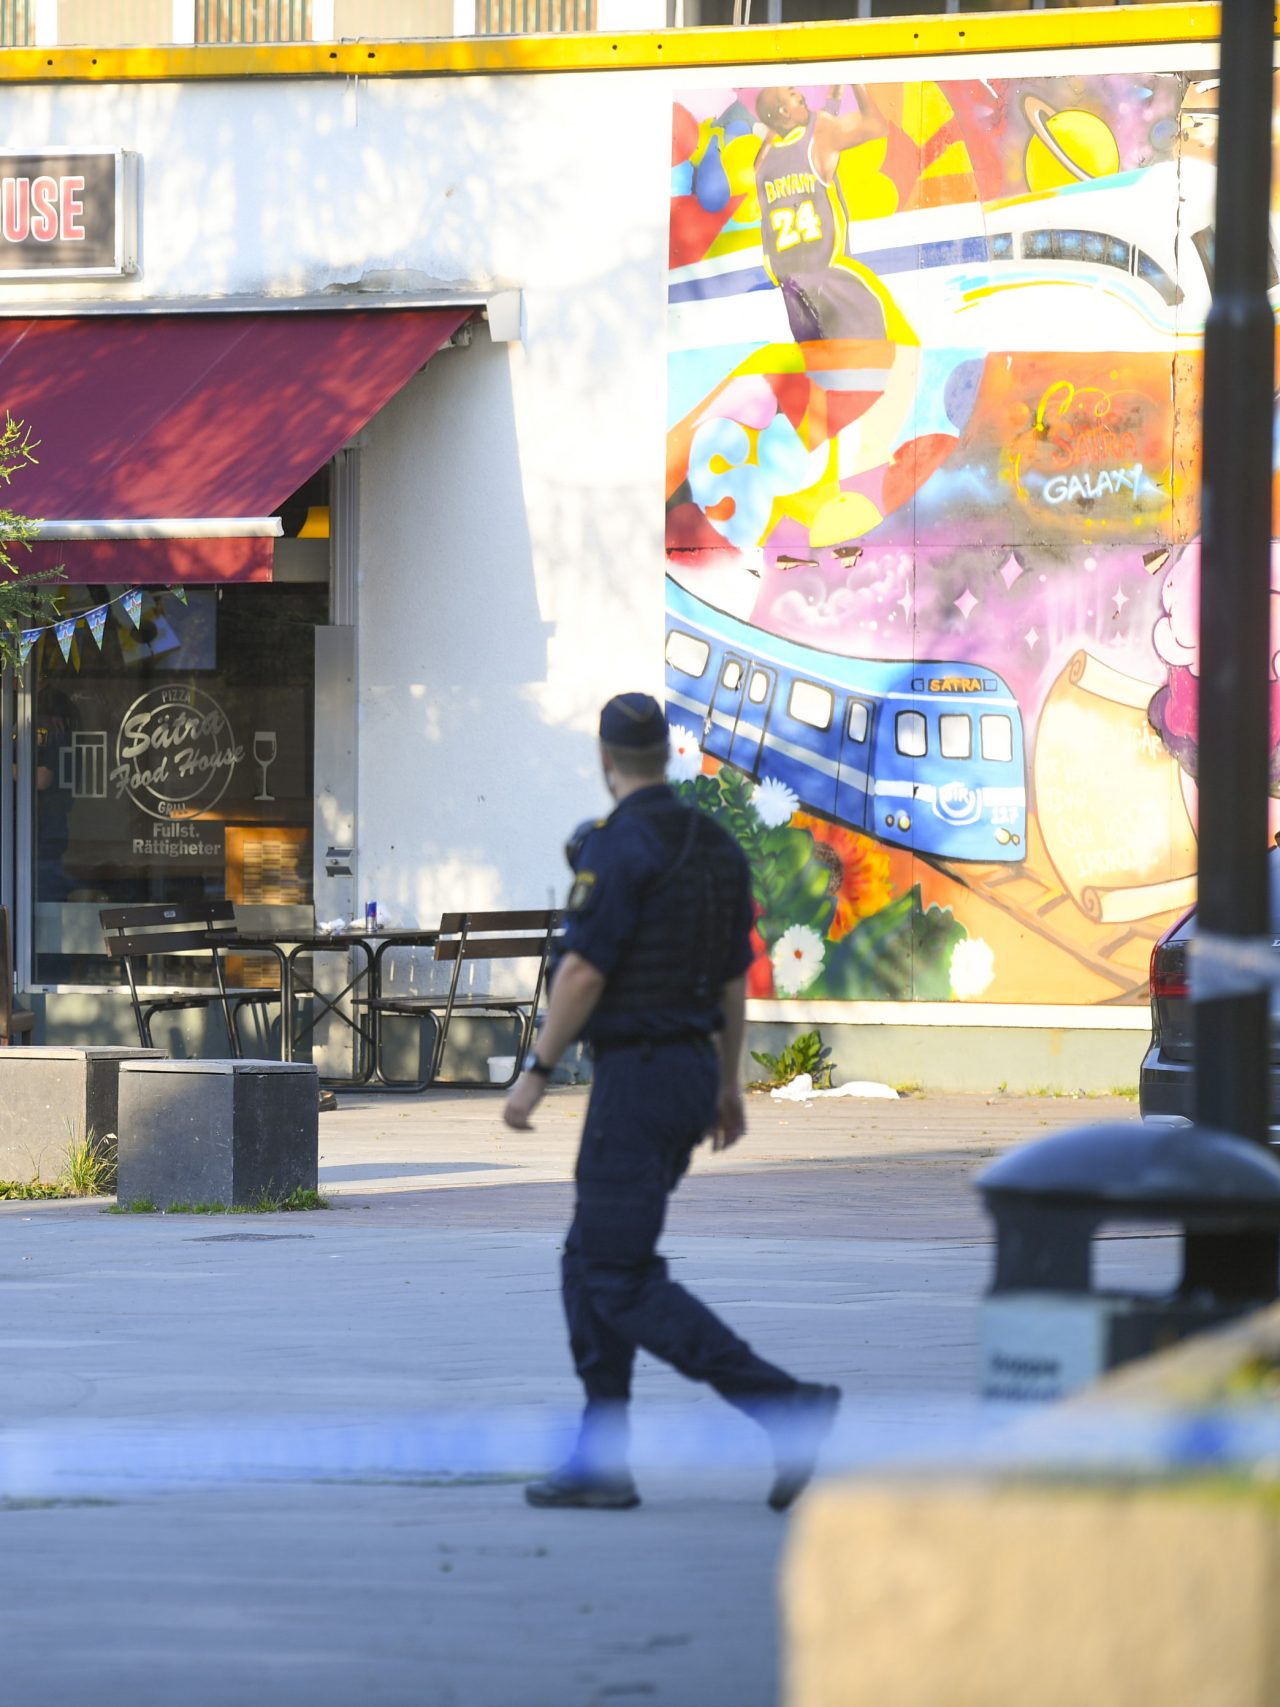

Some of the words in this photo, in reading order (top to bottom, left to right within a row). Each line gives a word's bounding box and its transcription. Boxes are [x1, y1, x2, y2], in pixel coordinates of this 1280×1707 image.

[764, 173, 817, 204] BRYANT
[769, 199, 823, 253] 24
[1042, 463, 1143, 504] GALAXY
[161, 689, 191, 703] PIZZA
[122, 710, 225, 758] Sätra
[110, 756, 169, 799] Food
[174, 745, 245, 777] House
[158, 801, 189, 816] GRILL
[153, 823, 200, 838] Fullst.
[132, 839, 221, 857] Rättigheter
